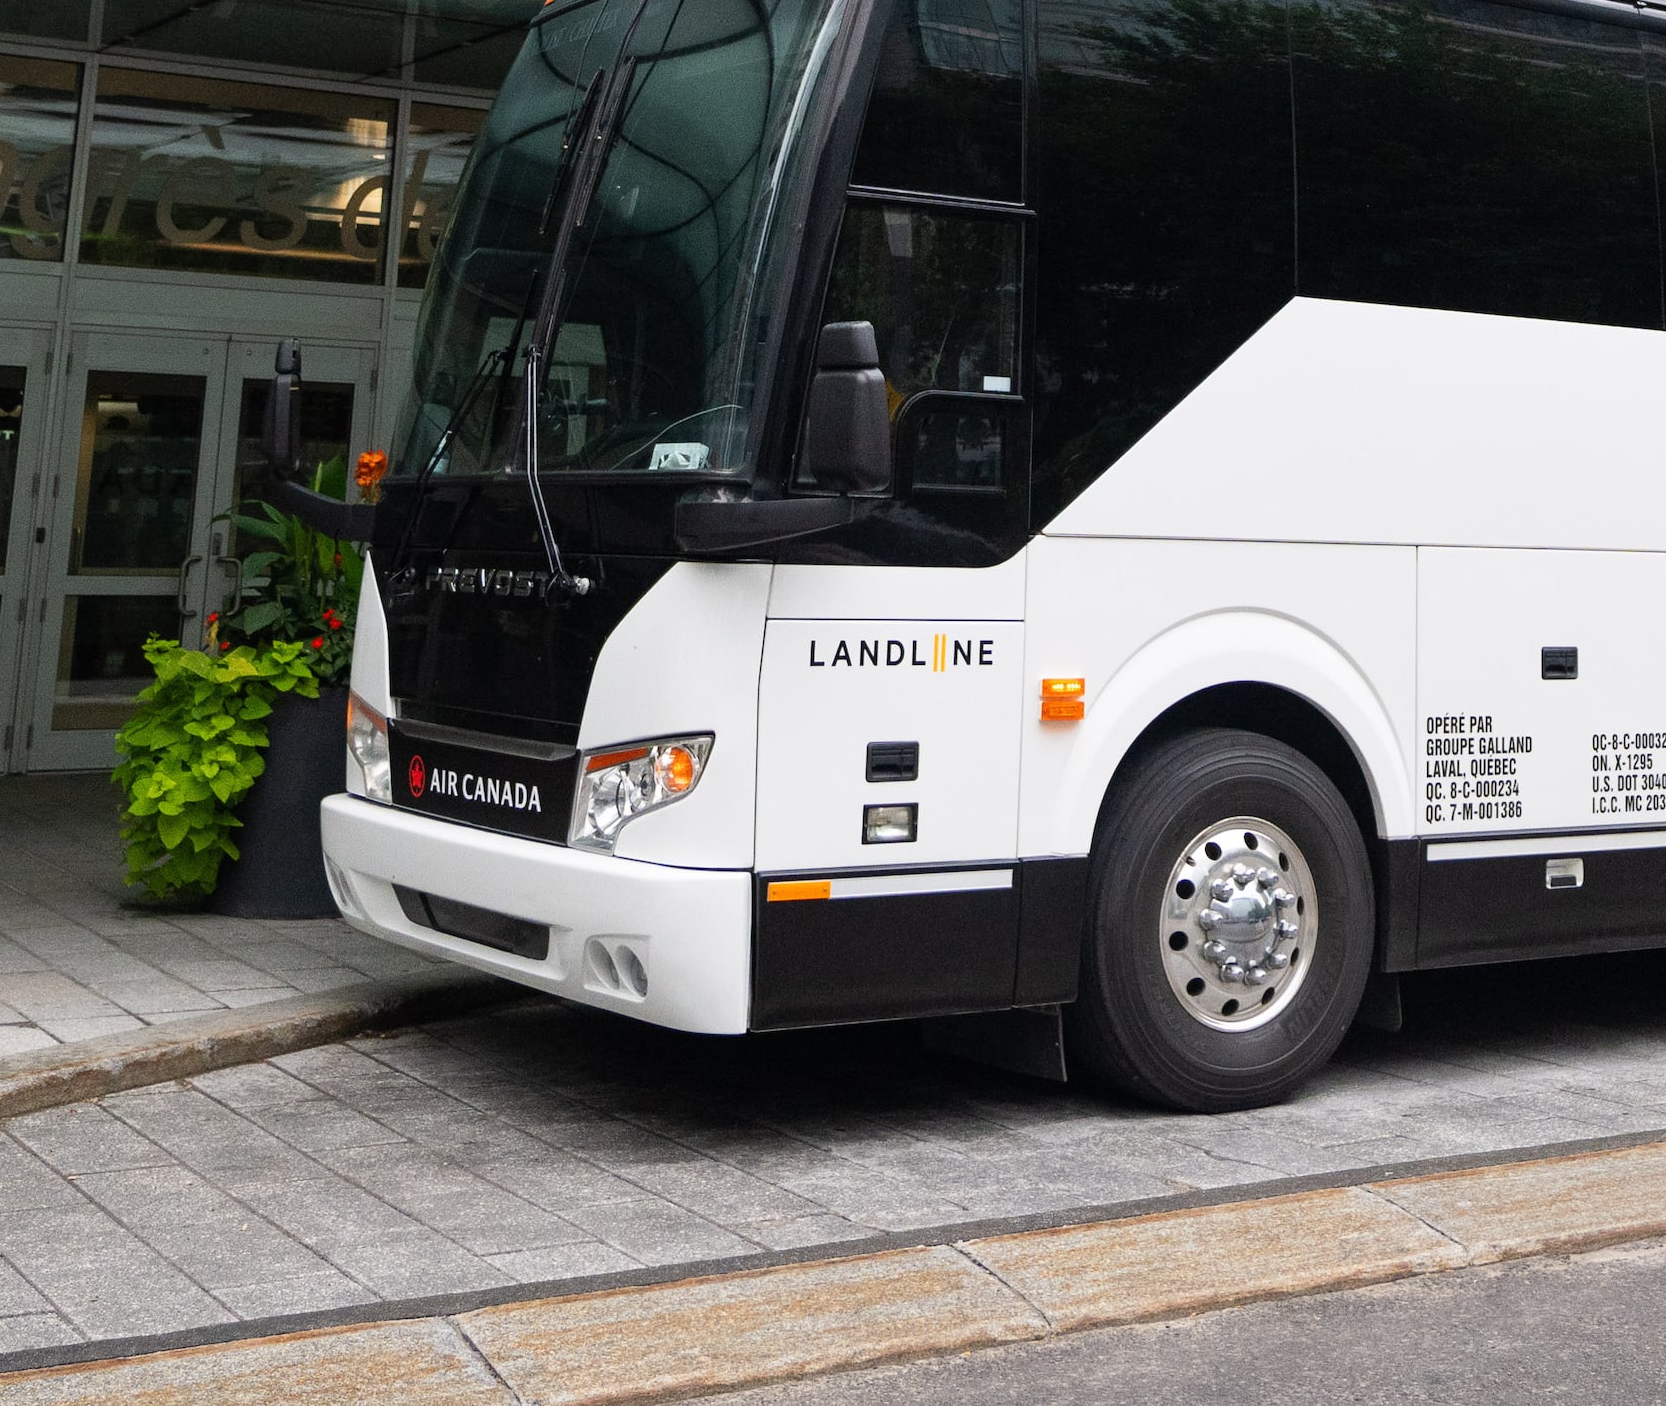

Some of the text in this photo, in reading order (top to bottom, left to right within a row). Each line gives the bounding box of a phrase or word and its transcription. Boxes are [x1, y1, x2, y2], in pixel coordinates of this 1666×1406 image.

[426, 567, 549, 598] PREVOST
[1426, 712, 1493, 735] OPÉRÉ PAR
[1426, 736, 1533, 757] GROUPE GALLAND
[1426, 755, 1517, 779] LAVAL, QUÉBEC
[1592, 753, 1653, 772] ON. X-1295
[430, 767, 542, 813] AIR CANADA
[1426, 779, 1520, 803] QC. 8-C-000234
[1592, 774, 1614, 793] U.S.
[1617, 774, 1638, 792] DOT
[1425, 800, 1523, 825] QC. 7-M-001386
[1592, 795, 1622, 814] I.C.C.
[1625, 794, 1643, 813] MC
